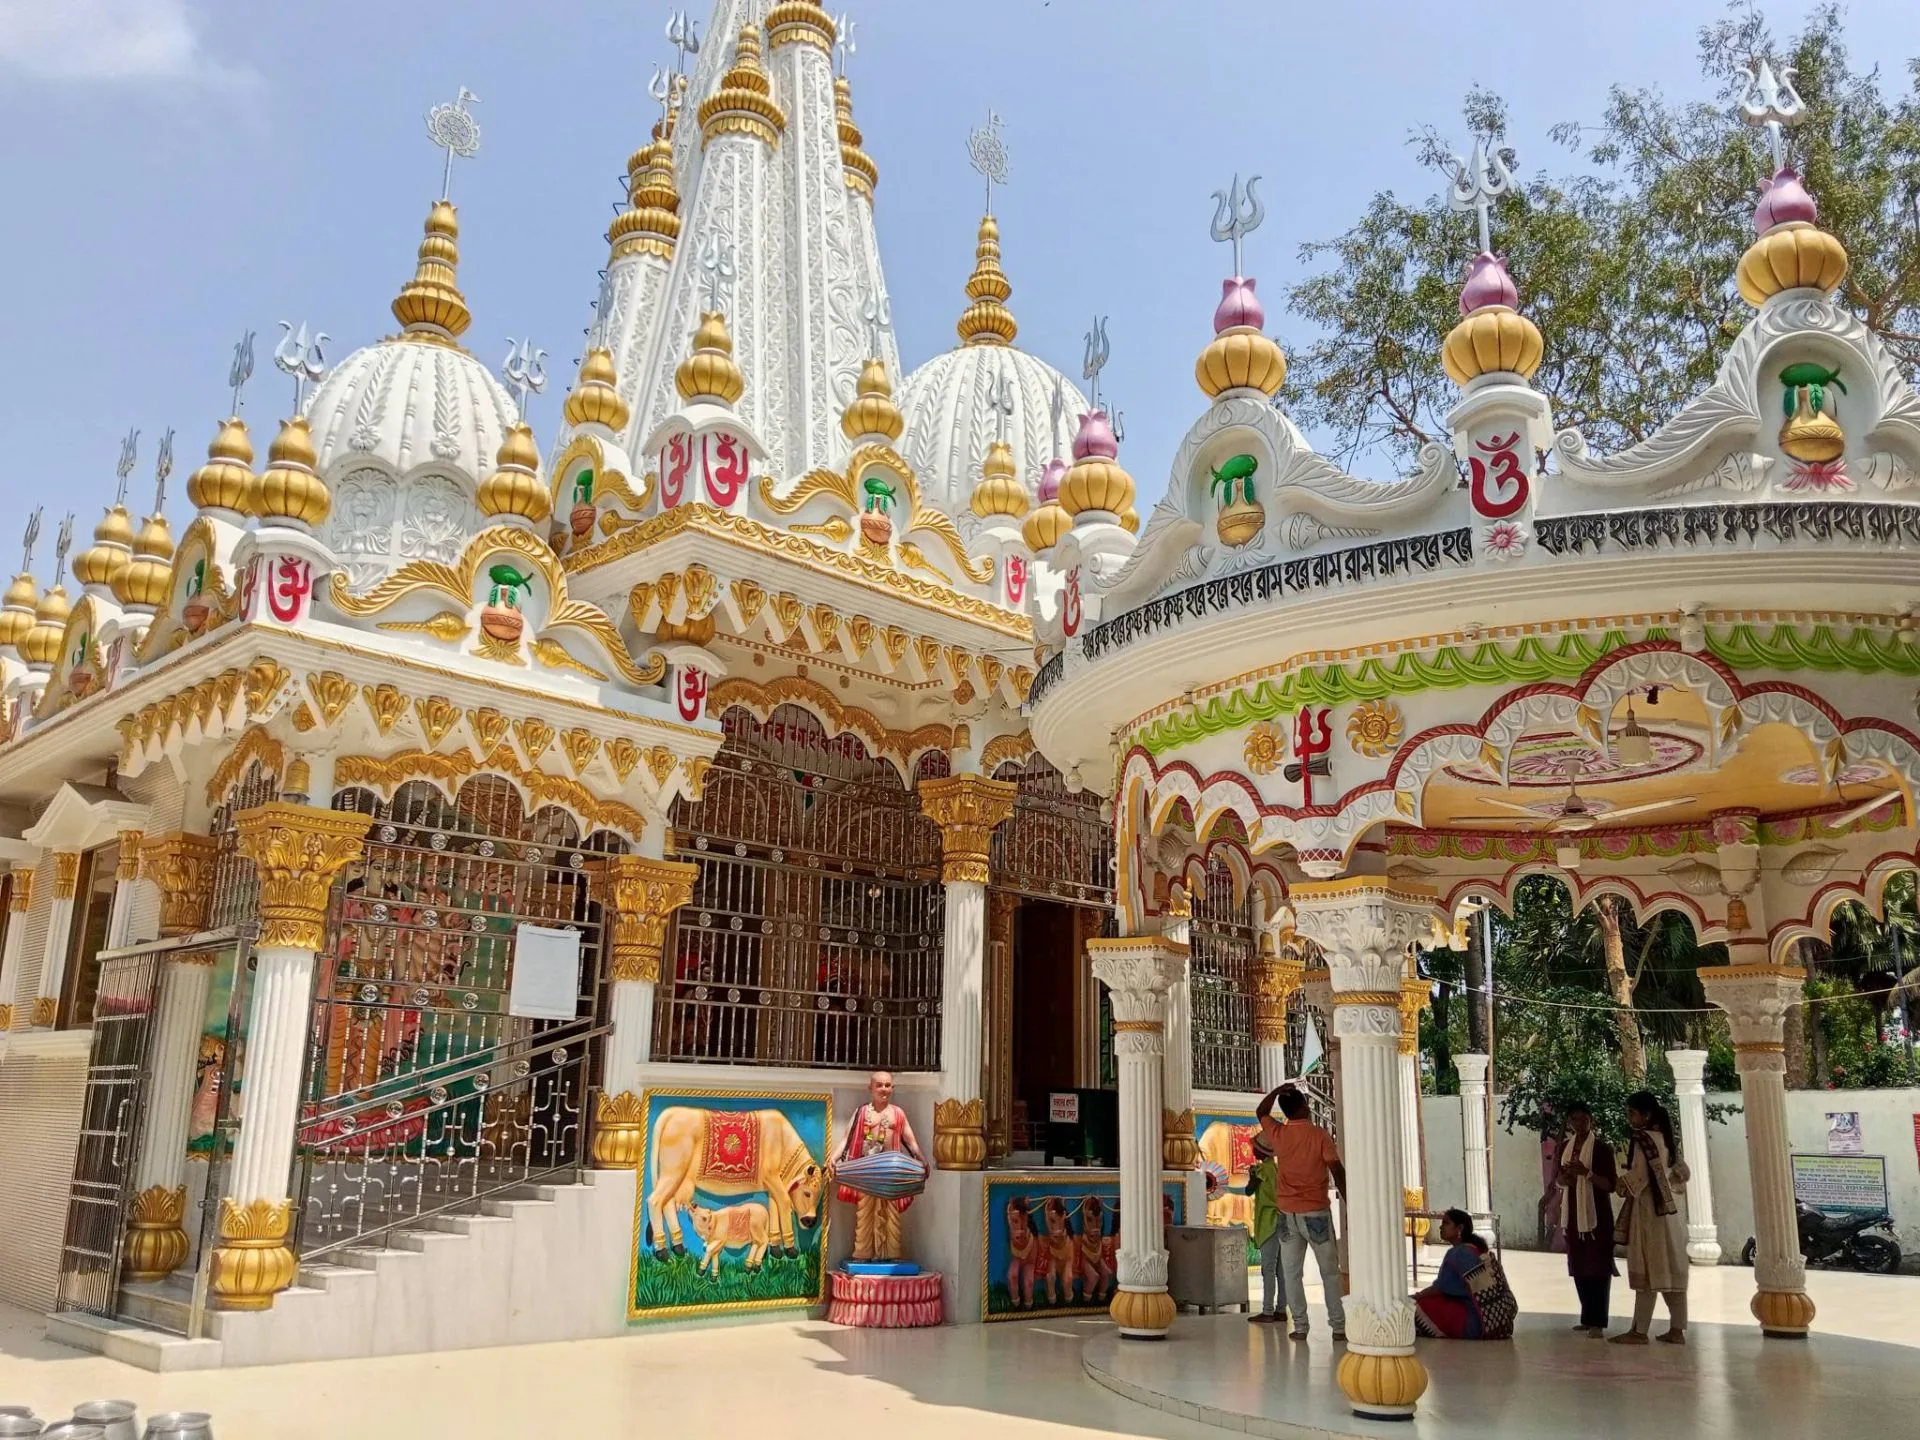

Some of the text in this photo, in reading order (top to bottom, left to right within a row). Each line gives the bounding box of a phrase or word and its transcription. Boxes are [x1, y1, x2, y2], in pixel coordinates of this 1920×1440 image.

[1533, 517, 1569, 557] হরে
[1607, 510, 1642, 551] হরে
[1761, 502, 1796, 543] হরে
[1796, 502, 1832, 542] হরে
[1832, 502, 1865, 540] হরে
[1865, 502, 1901, 542] রাম
[1185, 584, 1207, 618] হরে
[1206, 578, 1229, 612] হরে
[1229, 571, 1254, 606] হরে
[1255, 564, 1283, 600] রাম
[1284, 559, 1310, 592] হরে
[1311, 550, 1342, 587] রাম
[1344, 545, 1375, 580] রাম
[1375, 538, 1409, 574] রাম
[1408, 533, 1441, 568] হরে
[1440, 527, 1473, 565] হরে
